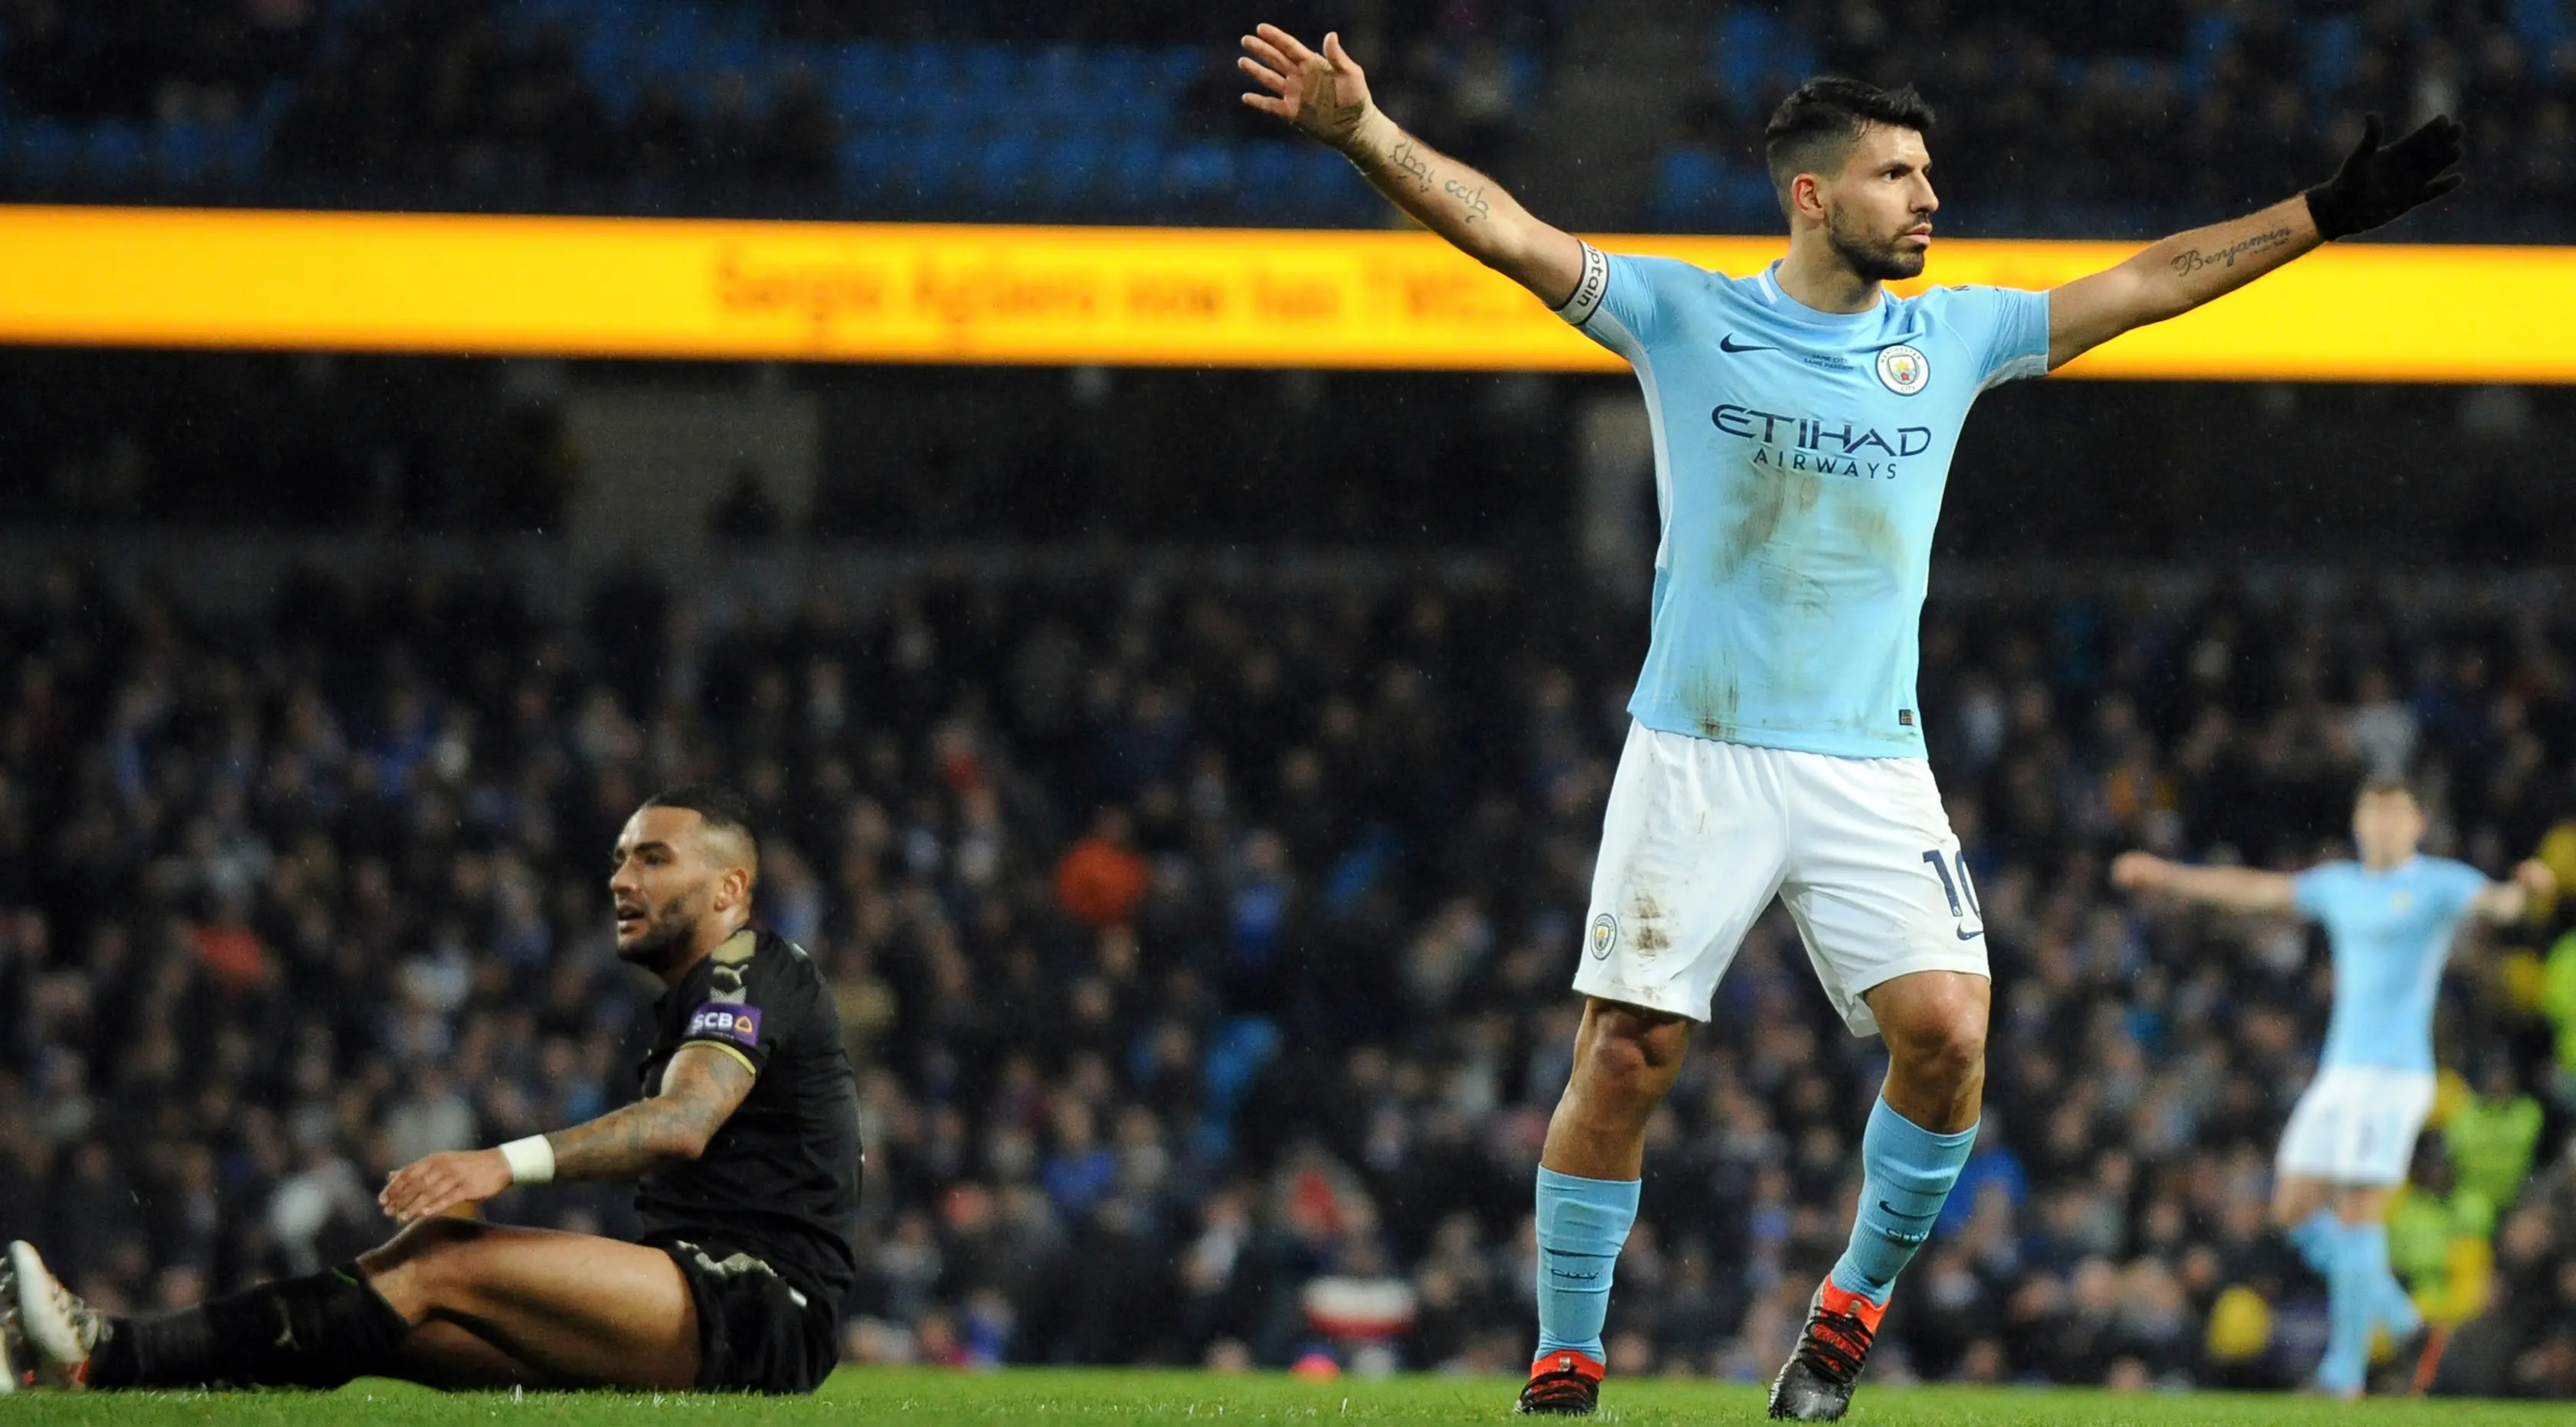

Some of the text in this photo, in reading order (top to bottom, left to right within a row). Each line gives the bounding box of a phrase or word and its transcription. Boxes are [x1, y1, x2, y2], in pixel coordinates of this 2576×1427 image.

[1577, 244, 1603, 307] ptain
[2171, 227, 2292, 277] Benjamin
[1711, 403, 1931, 457] ETIHAD
[1753, 448, 1898, 480] AIRWAYS
[691, 1011, 734, 1034] SCB
